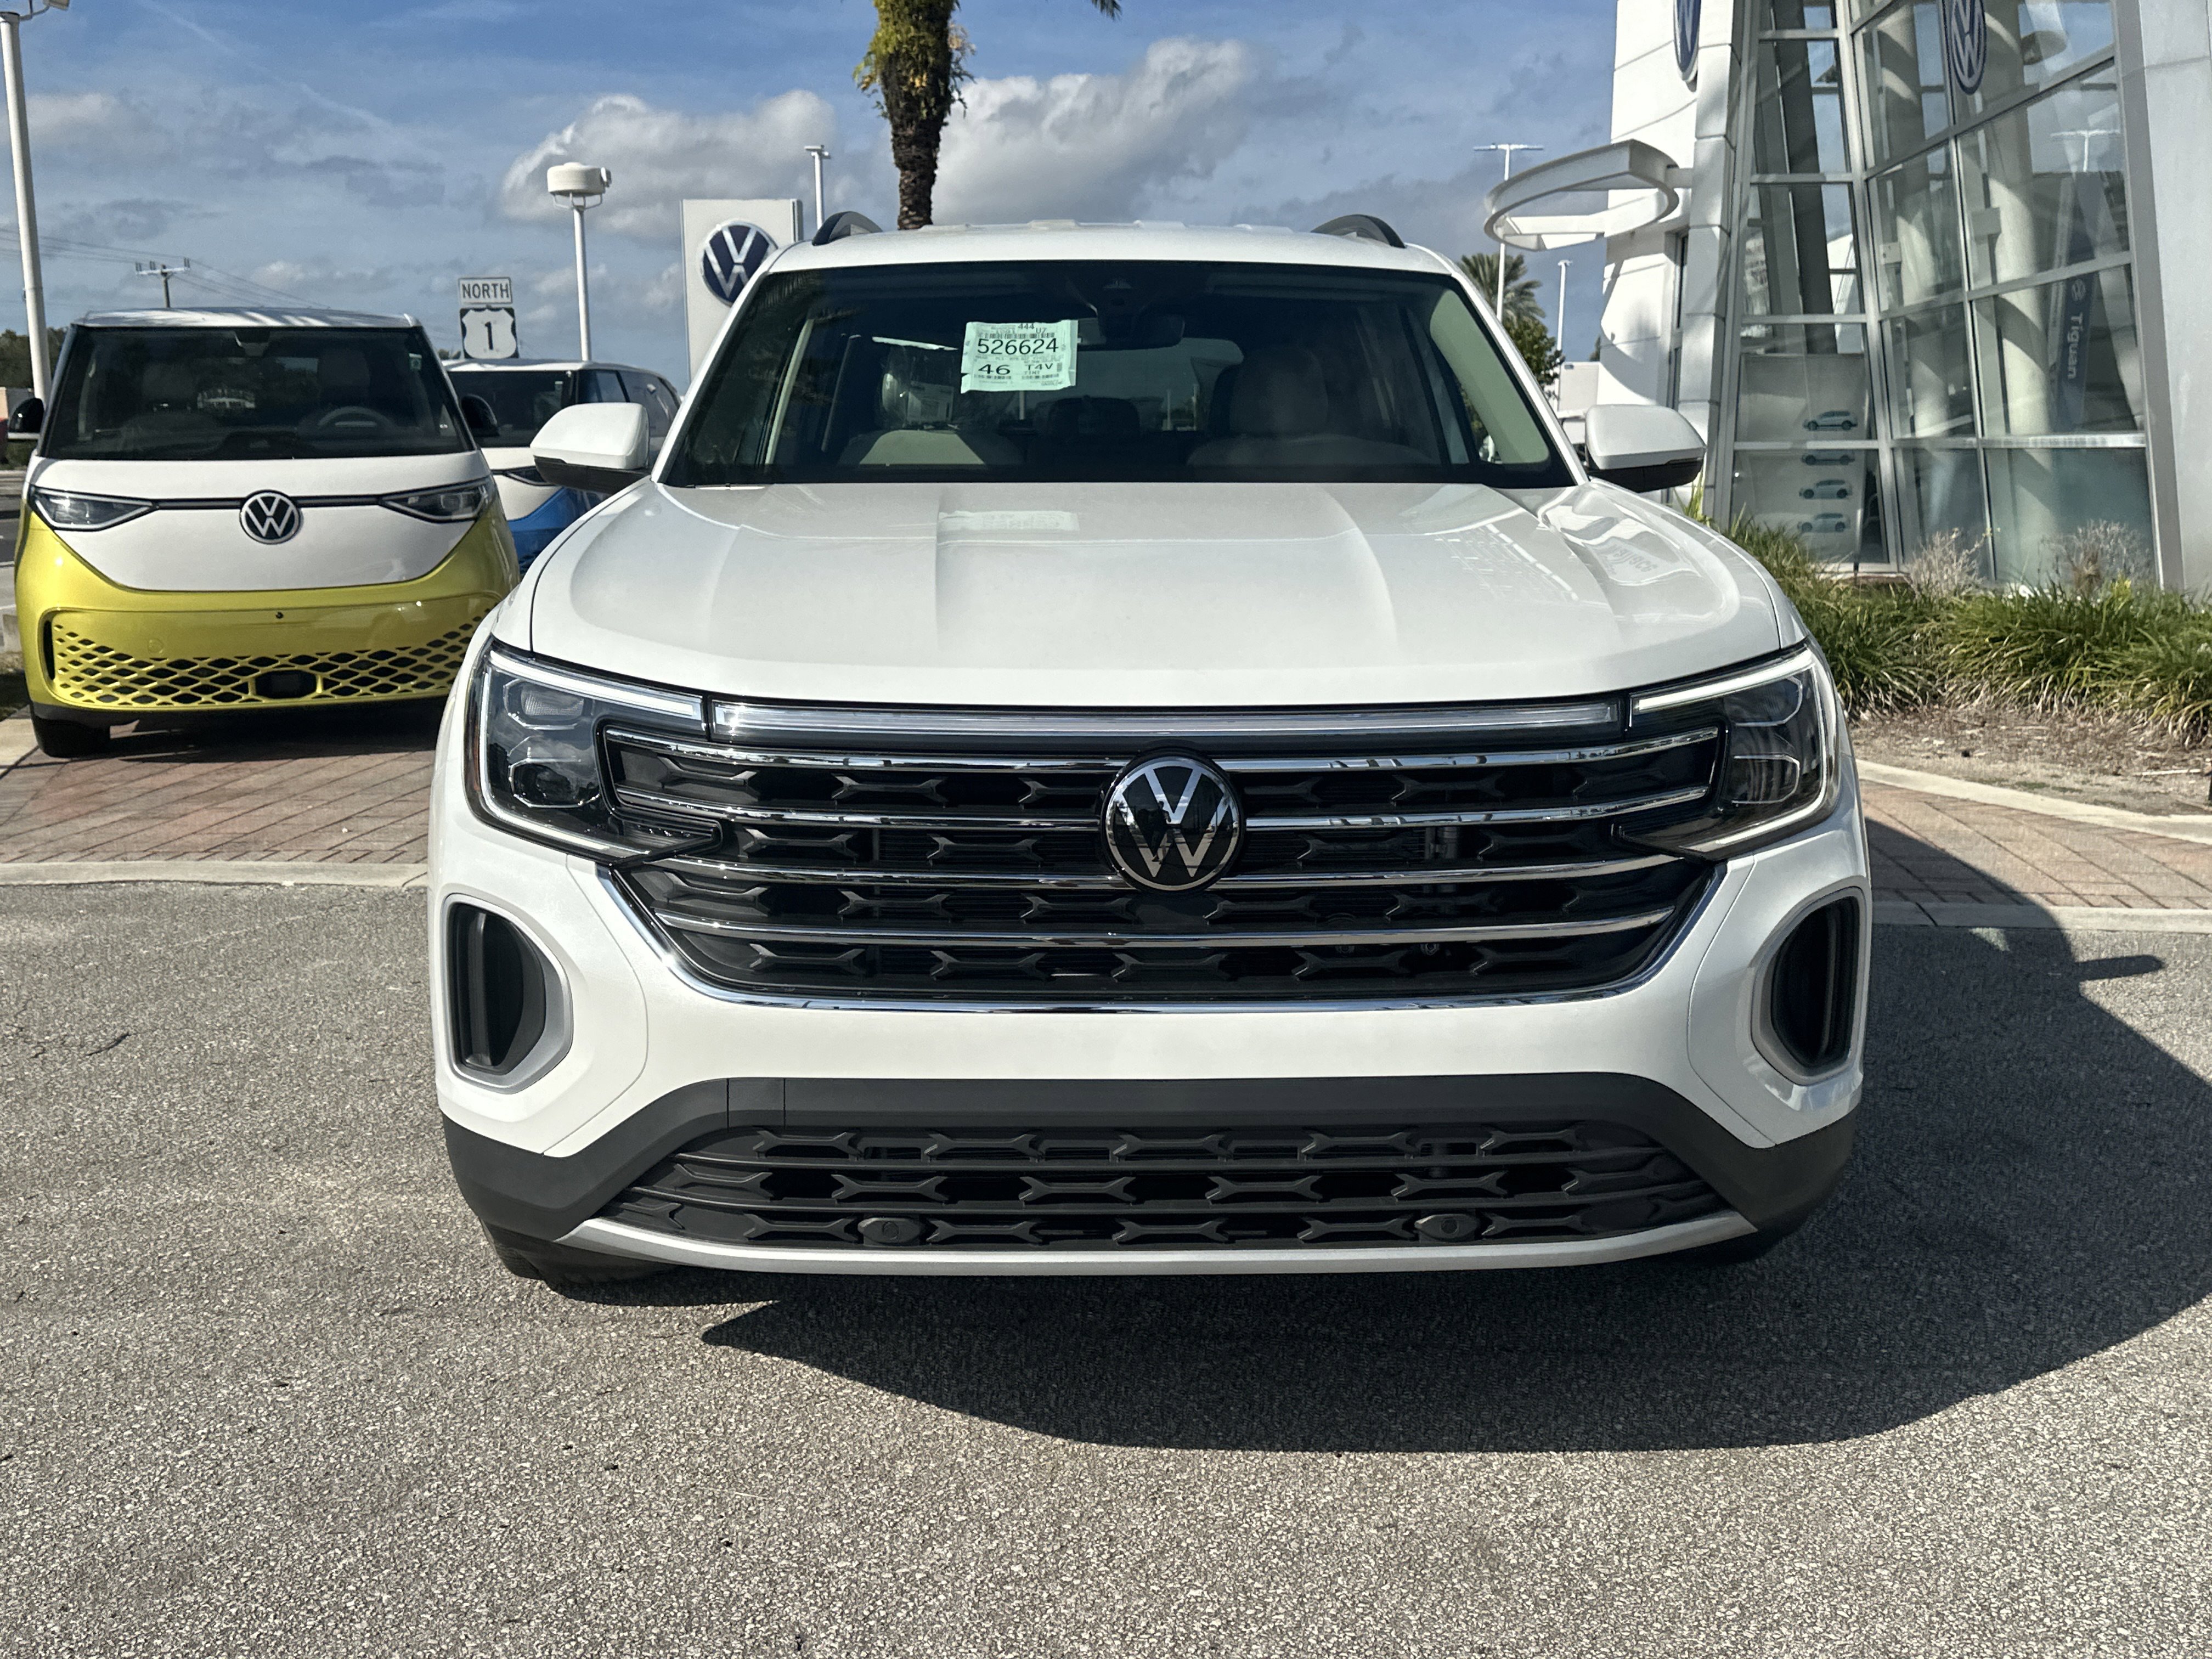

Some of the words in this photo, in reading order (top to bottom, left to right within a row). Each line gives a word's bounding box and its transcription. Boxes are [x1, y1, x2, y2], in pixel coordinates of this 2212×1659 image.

[462, 283, 509, 298] NORTH
[484, 321, 493, 350] 1
[977, 338, 1059, 355] 526624
[2067, 312, 2084, 379] Tiguan
[978, 364, 1011, 375] 46
[1025, 363, 1053, 371] T4V
